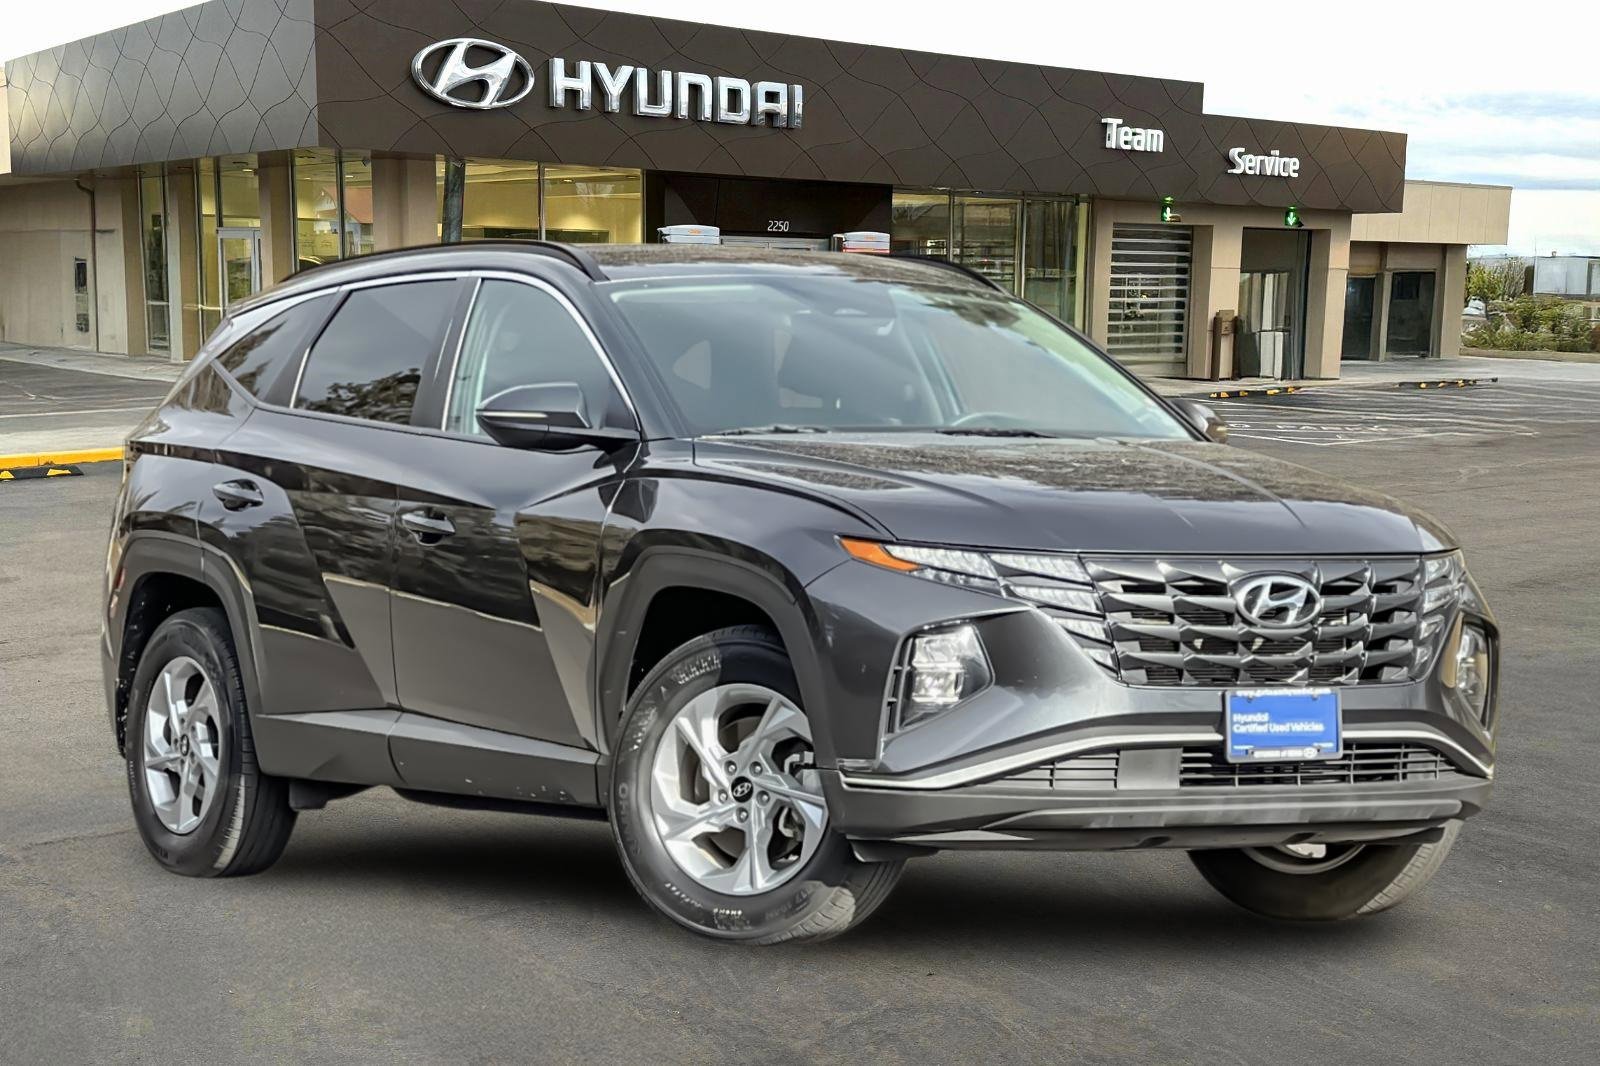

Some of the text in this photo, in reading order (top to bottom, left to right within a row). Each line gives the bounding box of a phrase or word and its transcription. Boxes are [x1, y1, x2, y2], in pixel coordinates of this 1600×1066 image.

[548, 57, 803, 129] HYUNDAI
[1101, 117, 1164, 153] Team
[1227, 147, 1300, 178] Service
[767, 220, 790, 232] 2250
[1232, 712, 1269, 724] Hyundai
[1232, 721, 1325, 733] Certified Used Vehicles
